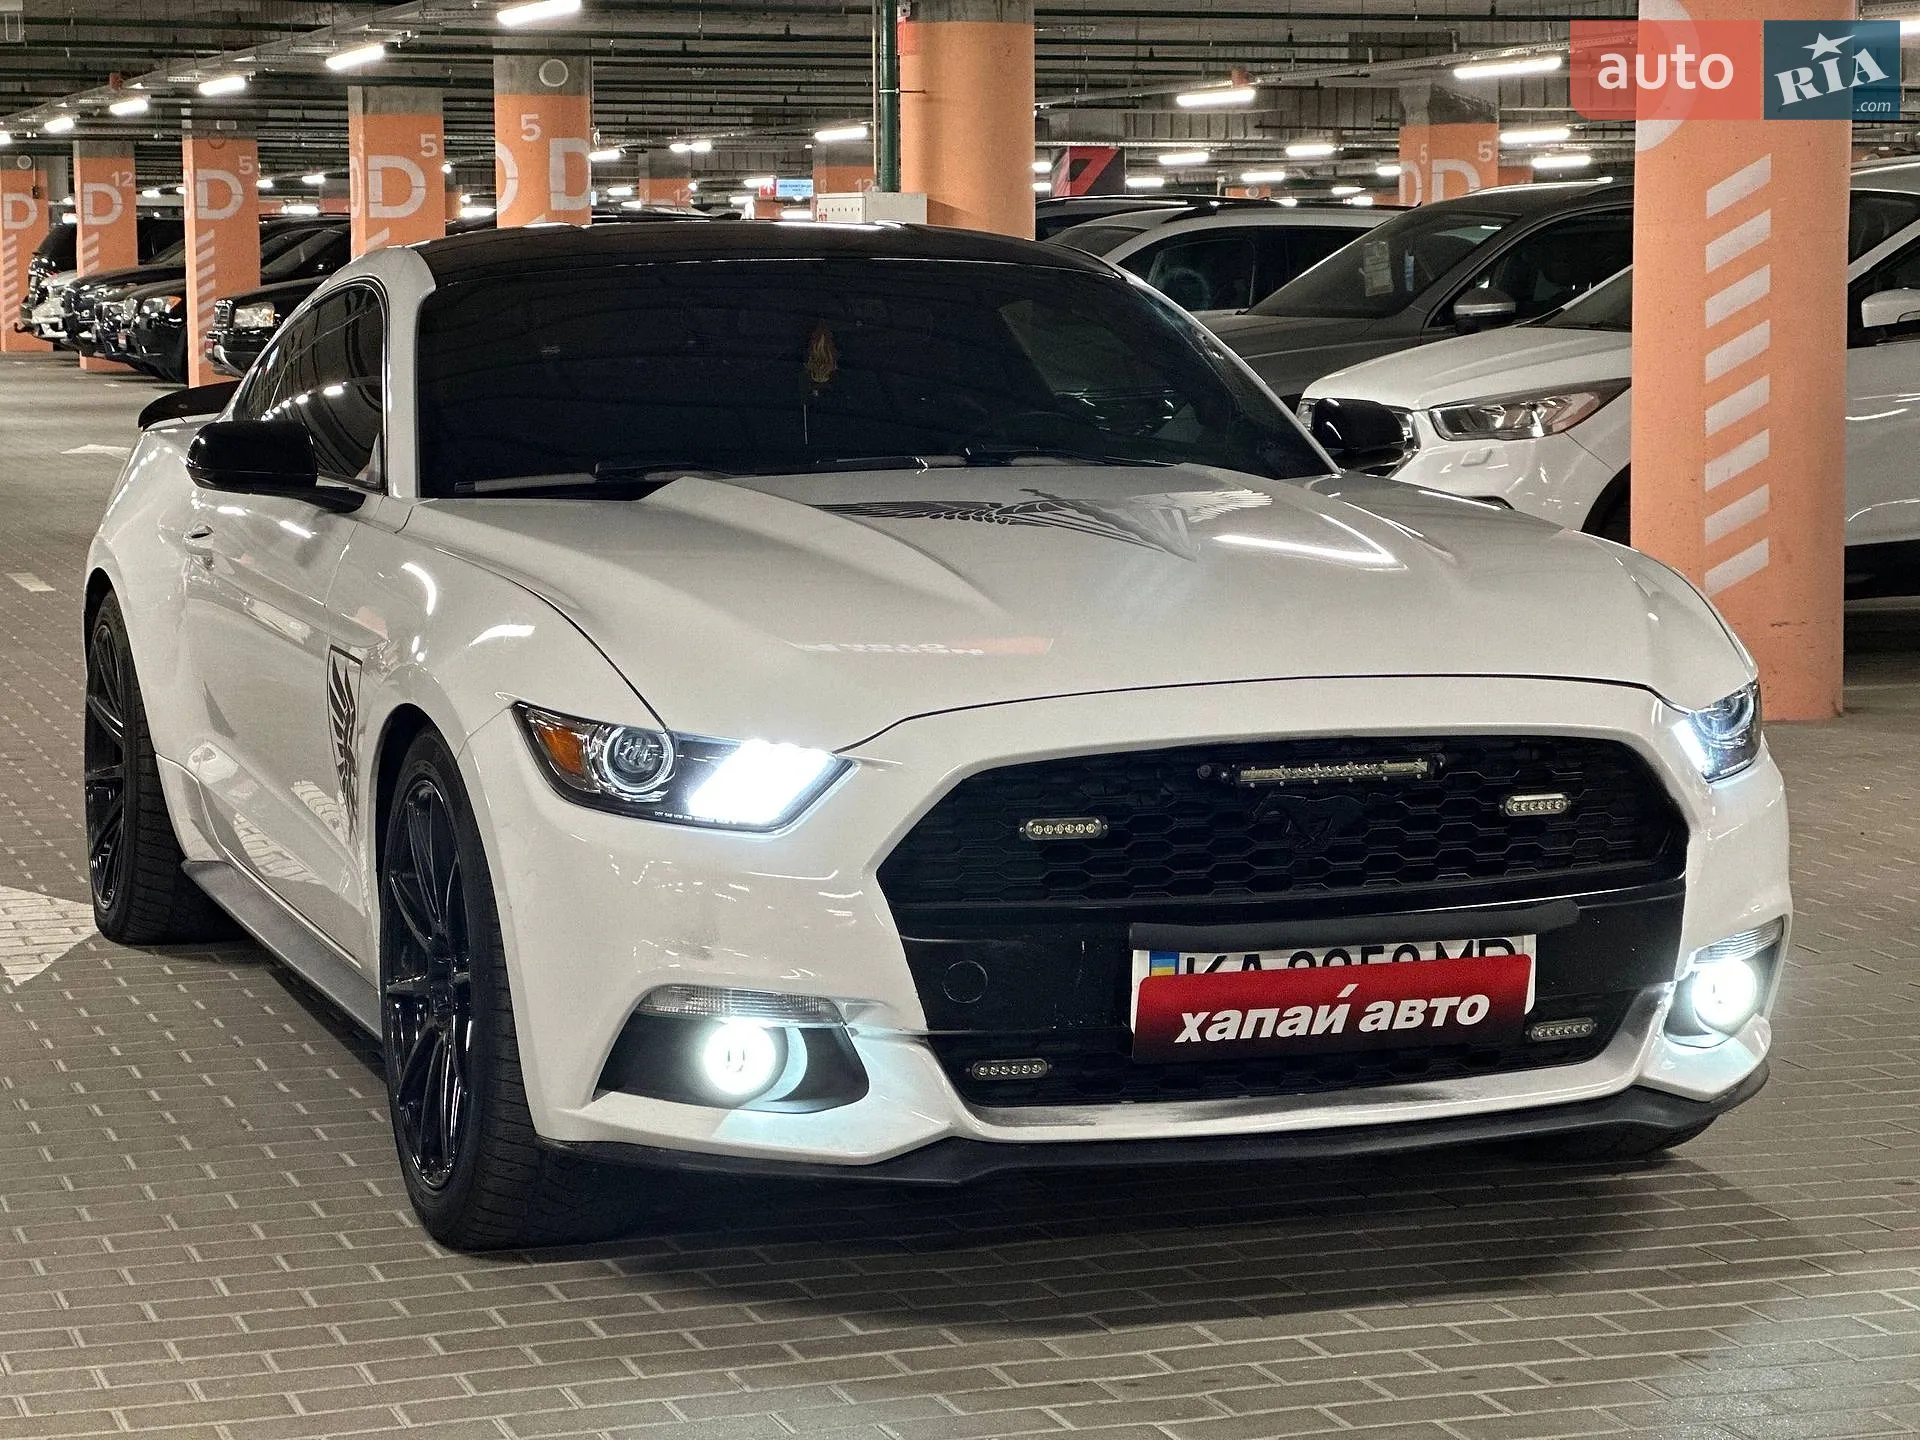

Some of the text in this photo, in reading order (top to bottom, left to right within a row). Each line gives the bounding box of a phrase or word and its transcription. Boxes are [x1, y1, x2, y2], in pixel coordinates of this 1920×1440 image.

[521, 113, 540, 141] 5
[550, 137, 591, 211] D
[1478, 141, 1493, 162] 5
[83, 171, 134, 225] D 12
[196, 156, 254, 220] D 5
[368, 133, 438, 218] D 5
[2, 193, 38, 230] D
[1358, 994, 1491, 1033] авто
